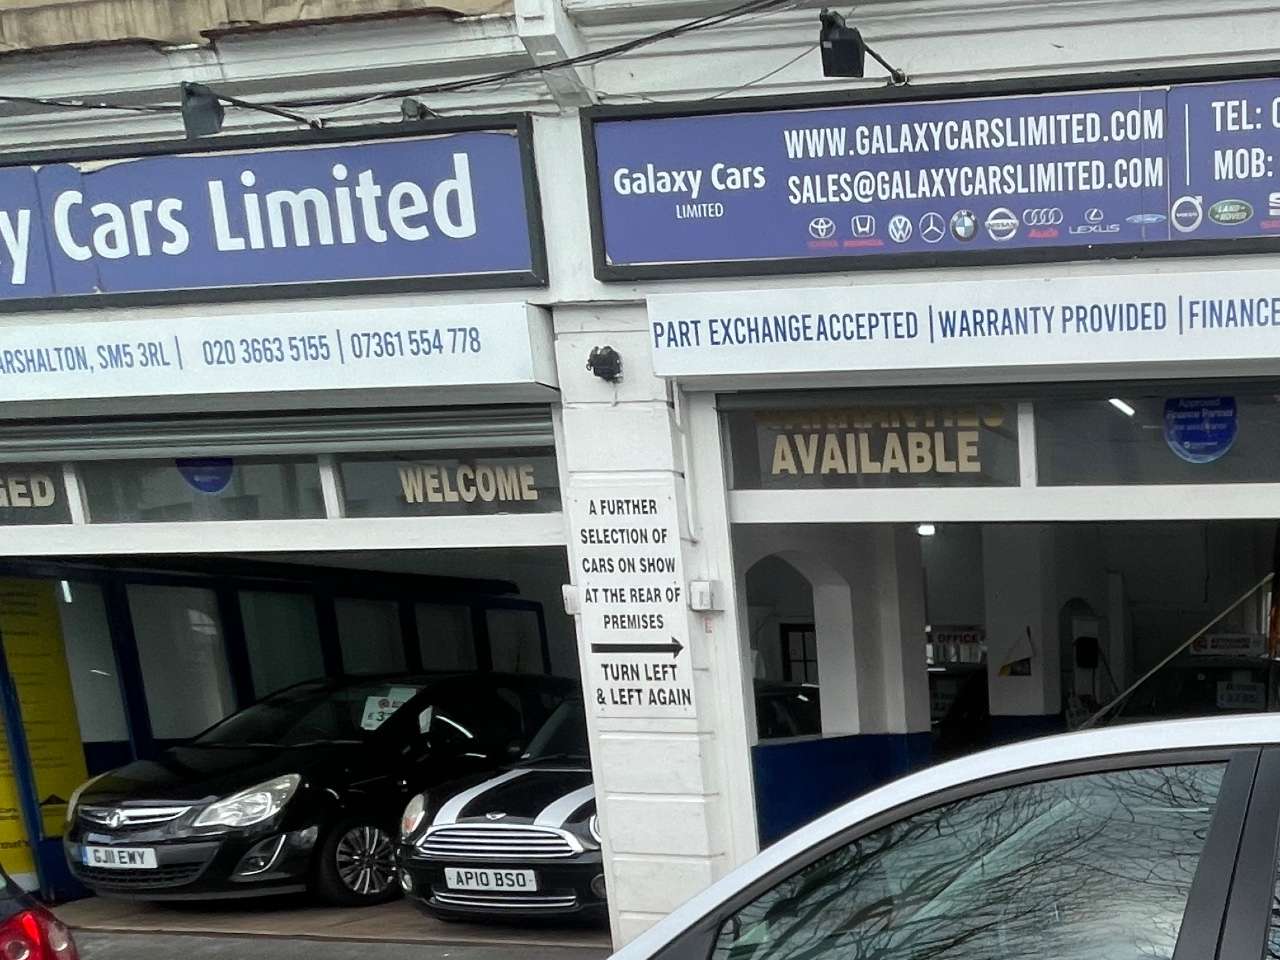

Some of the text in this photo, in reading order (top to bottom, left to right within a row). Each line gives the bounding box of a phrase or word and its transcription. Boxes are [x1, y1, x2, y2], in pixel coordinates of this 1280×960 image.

[1212, 101, 1263, 133] TEL:
[784, 108, 1165, 160] WWW.GALAXYCARSLIMITED.COM
[1213, 148, 1274, 181] MOB:
[614, 162, 766, 199] Galaxy Cars
[787, 157, 1164, 206] SALES@GALAXYCARSLIMITED.COM
[54, 189, 190, 261] Cars
[208, 152, 477, 251] Limited
[676, 203, 724, 220] LIMITED
[1069, 224, 1121, 234] LEXUS
[1062, 302, 1167, 334] PROVIDED
[203, 334, 331, 366] 020 3663 5155
[351, 327, 482, 359] 07361 554 778
[653, 320, 702, 349] PART
[97, 343, 135, 370] SM5
[139, 339, 170, 367] 3RL
[771, 431, 982, 474] AVAILABLE
[400, 464, 540, 503] WELCOME
[589, 499, 658, 515] A FURTHER
[580, 528, 668, 545] SELECTION OF
[582, 556, 676, 574] CARS ON SHOW
[585, 587, 681, 603] AT THE REAR OF
[603, 614, 664, 630] PREMISES
[601, 663, 678, 681] TURN LEFT
[596, 688, 692, 706] & LEFT AGAIN
[456, 871, 490, 887] AP10
